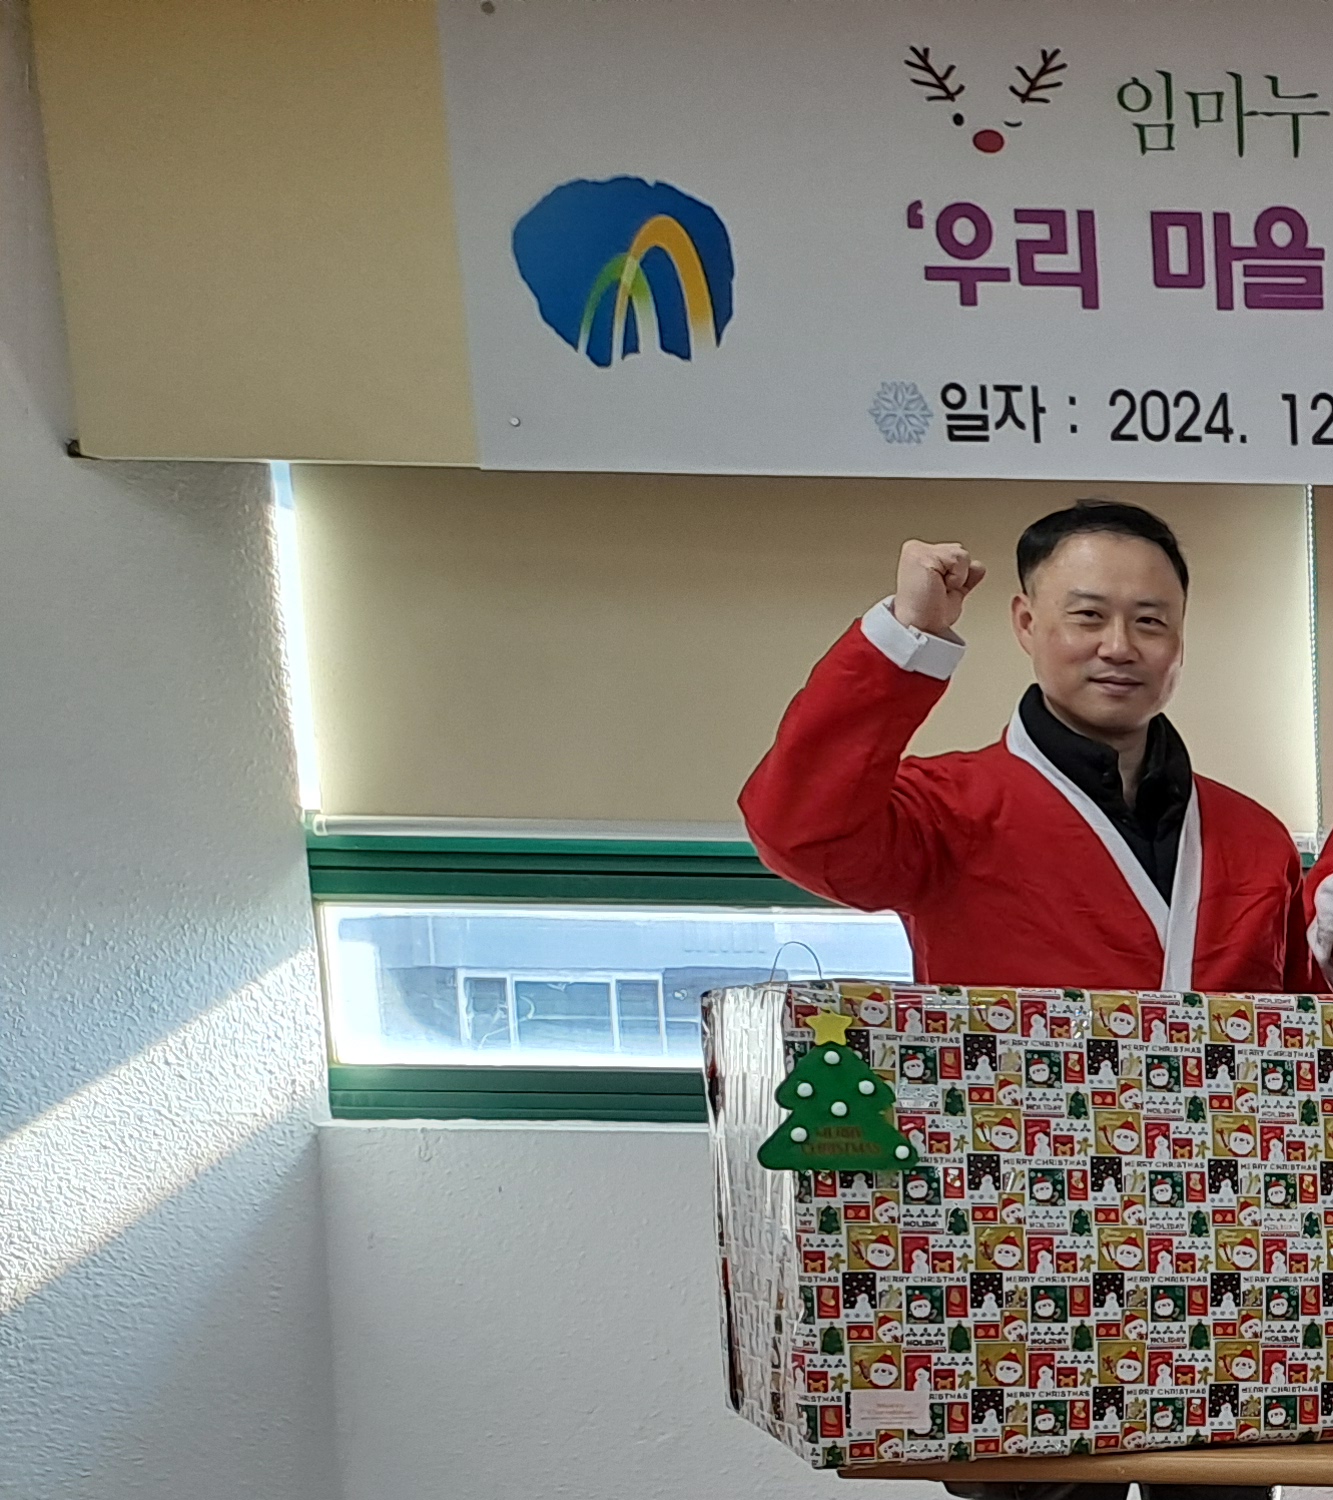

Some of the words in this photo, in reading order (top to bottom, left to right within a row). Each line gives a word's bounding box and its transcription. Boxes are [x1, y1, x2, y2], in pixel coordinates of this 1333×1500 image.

[1150, 206, 1325, 311] 마을
[940, 382, 1046, 443] 일자
[1109, 389, 1248, 443] 2024.
[929, 1392, 968, 1400] RISTMAS
